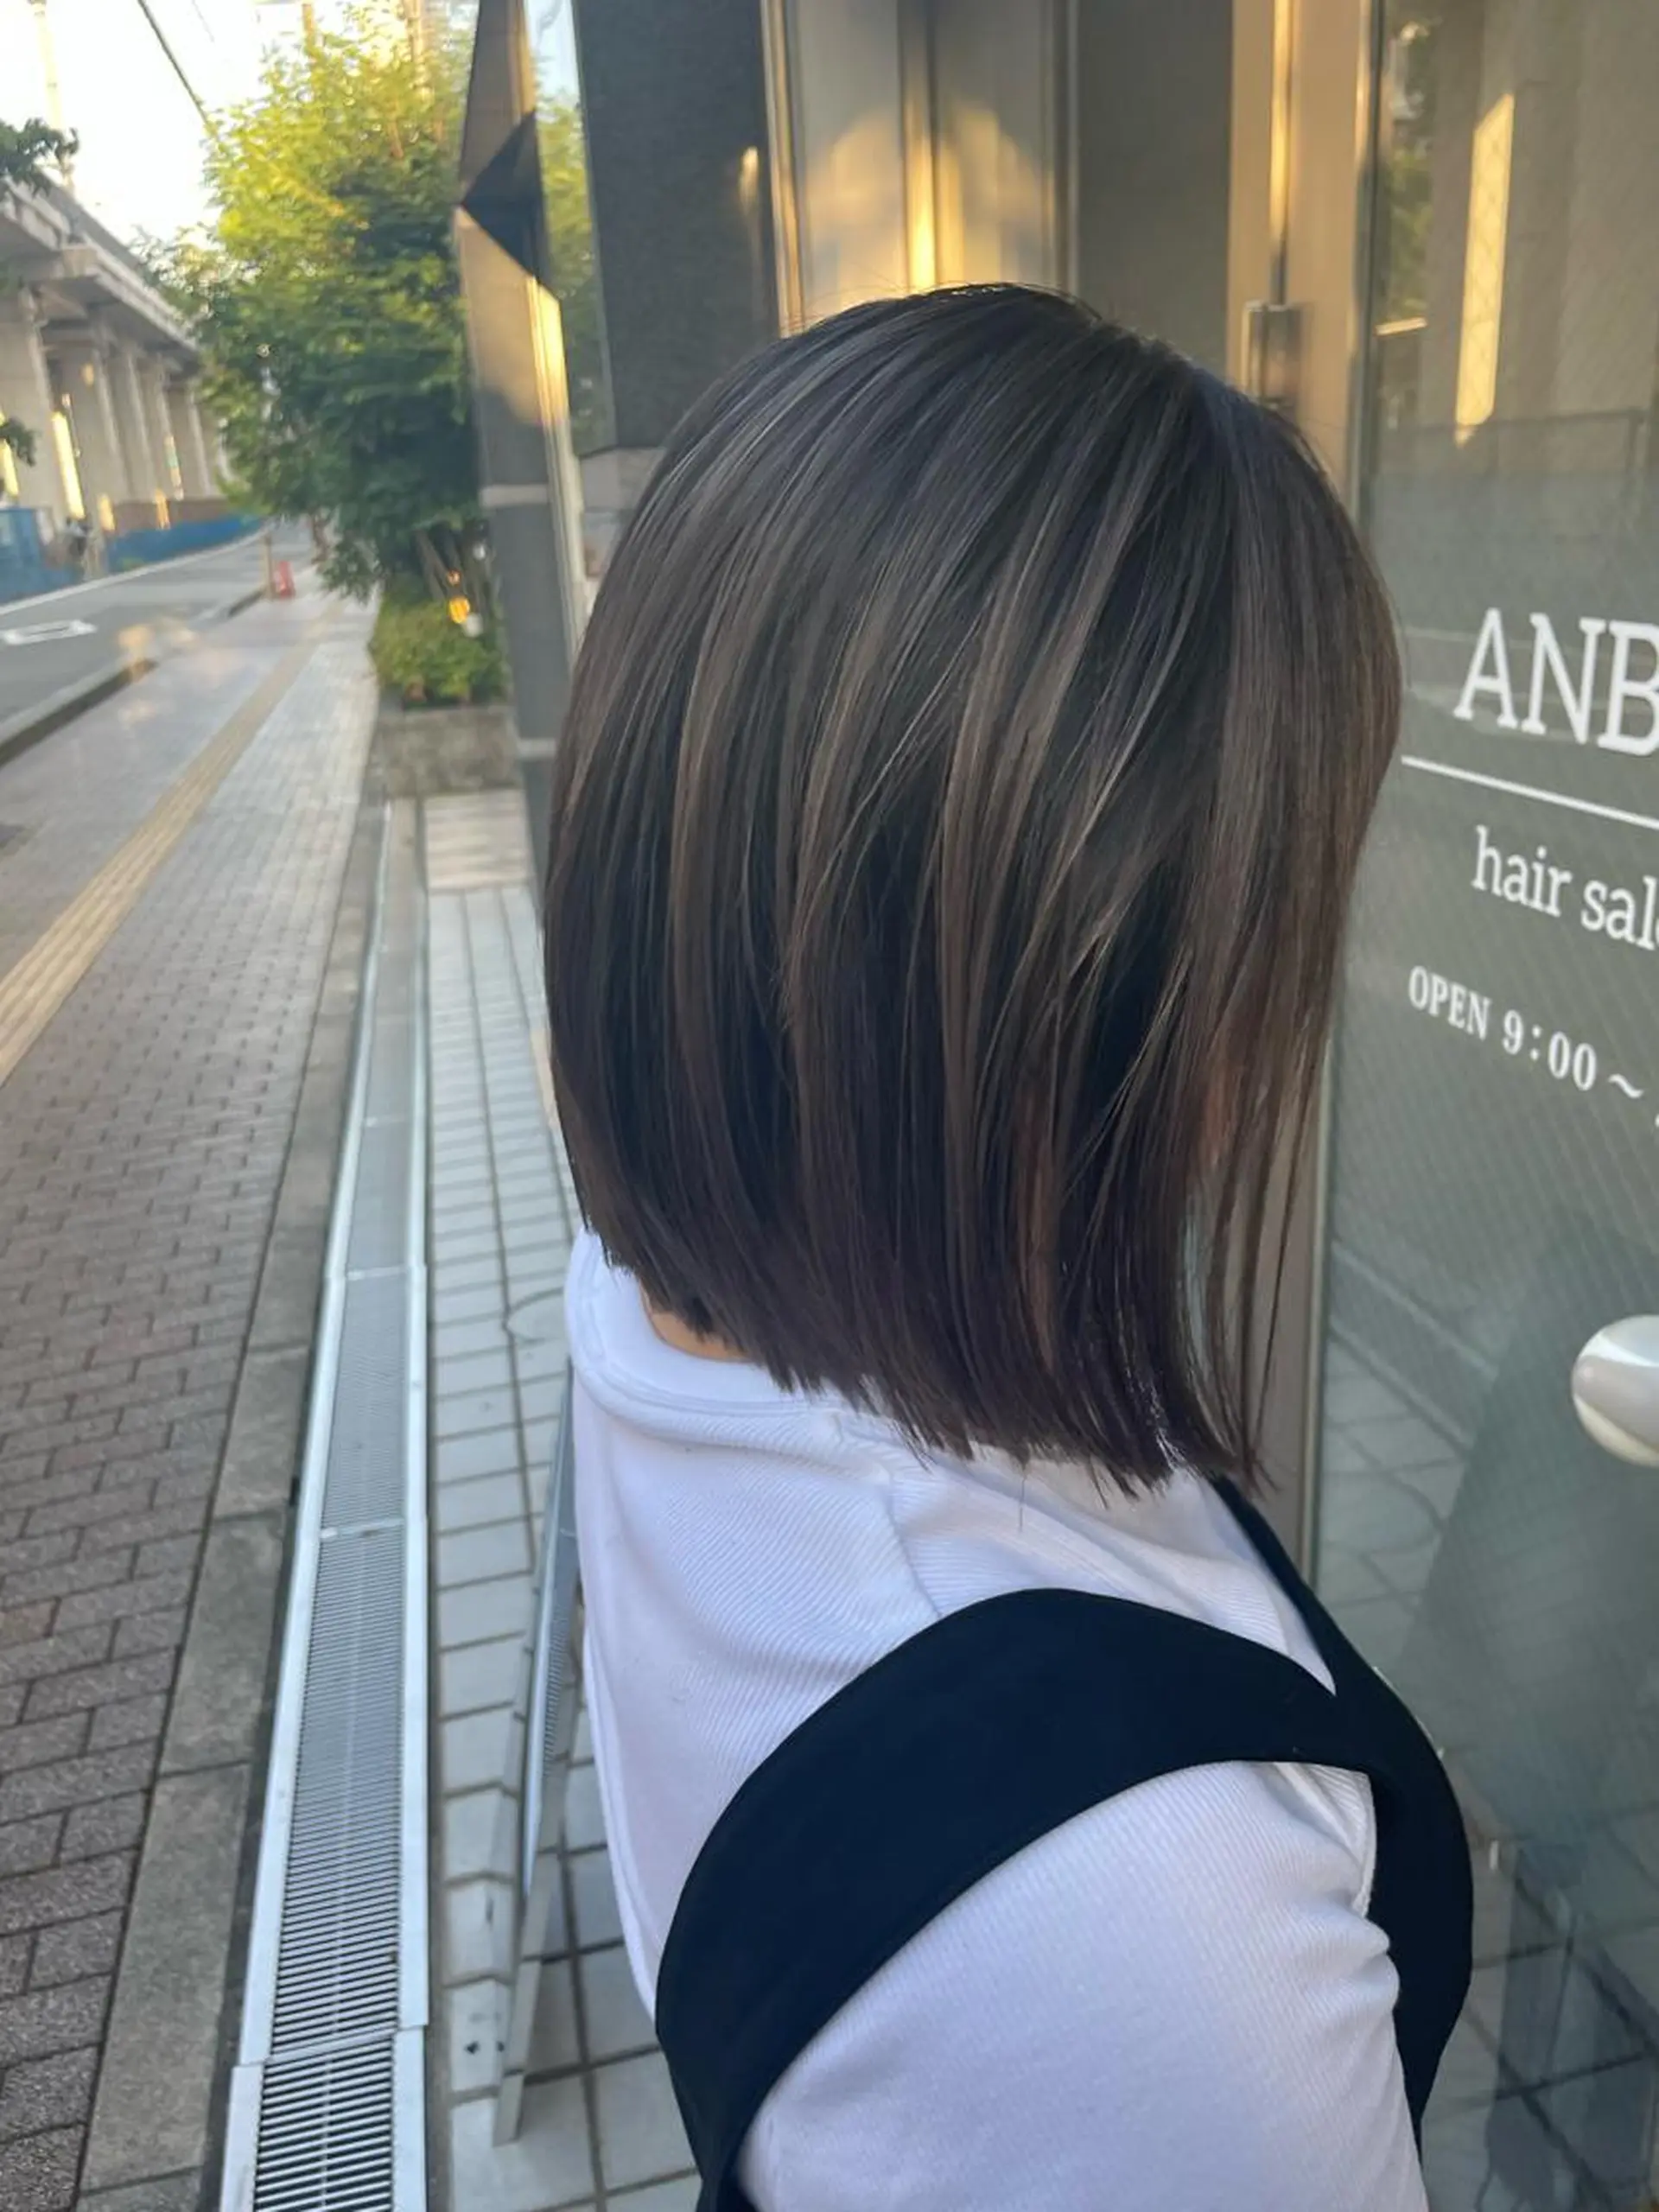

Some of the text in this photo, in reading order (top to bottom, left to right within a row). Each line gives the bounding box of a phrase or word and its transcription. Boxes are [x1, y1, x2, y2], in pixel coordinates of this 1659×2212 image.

[1471, 824, 1659, 950] hair sal
[1408, 965, 1491, 1040] OPEN
